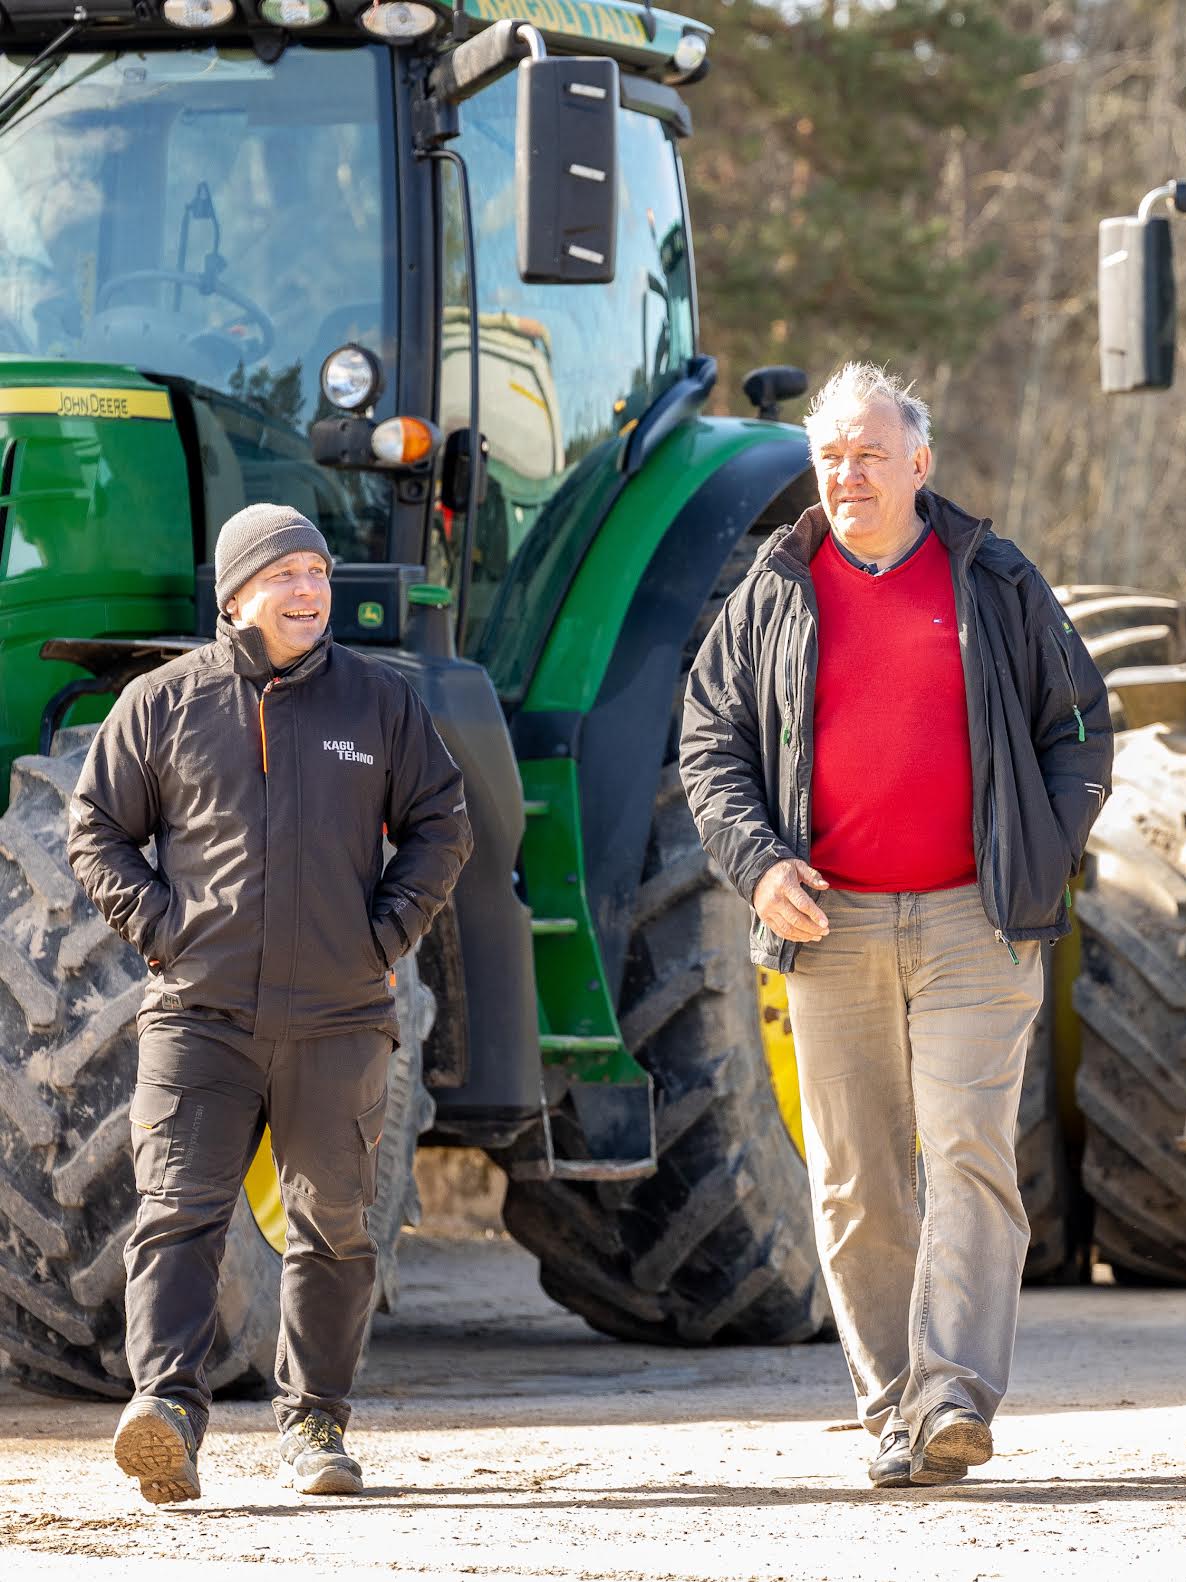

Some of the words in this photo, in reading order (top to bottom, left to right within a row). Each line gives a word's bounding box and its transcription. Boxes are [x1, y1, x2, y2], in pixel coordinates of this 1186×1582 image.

[58, 391, 89, 411] JOHN
[90, 393, 129, 414] DEERE
[323, 740, 355, 751] KAGU
[336, 750, 374, 765] TEHNO
[191, 1104, 204, 1132] HELLY
